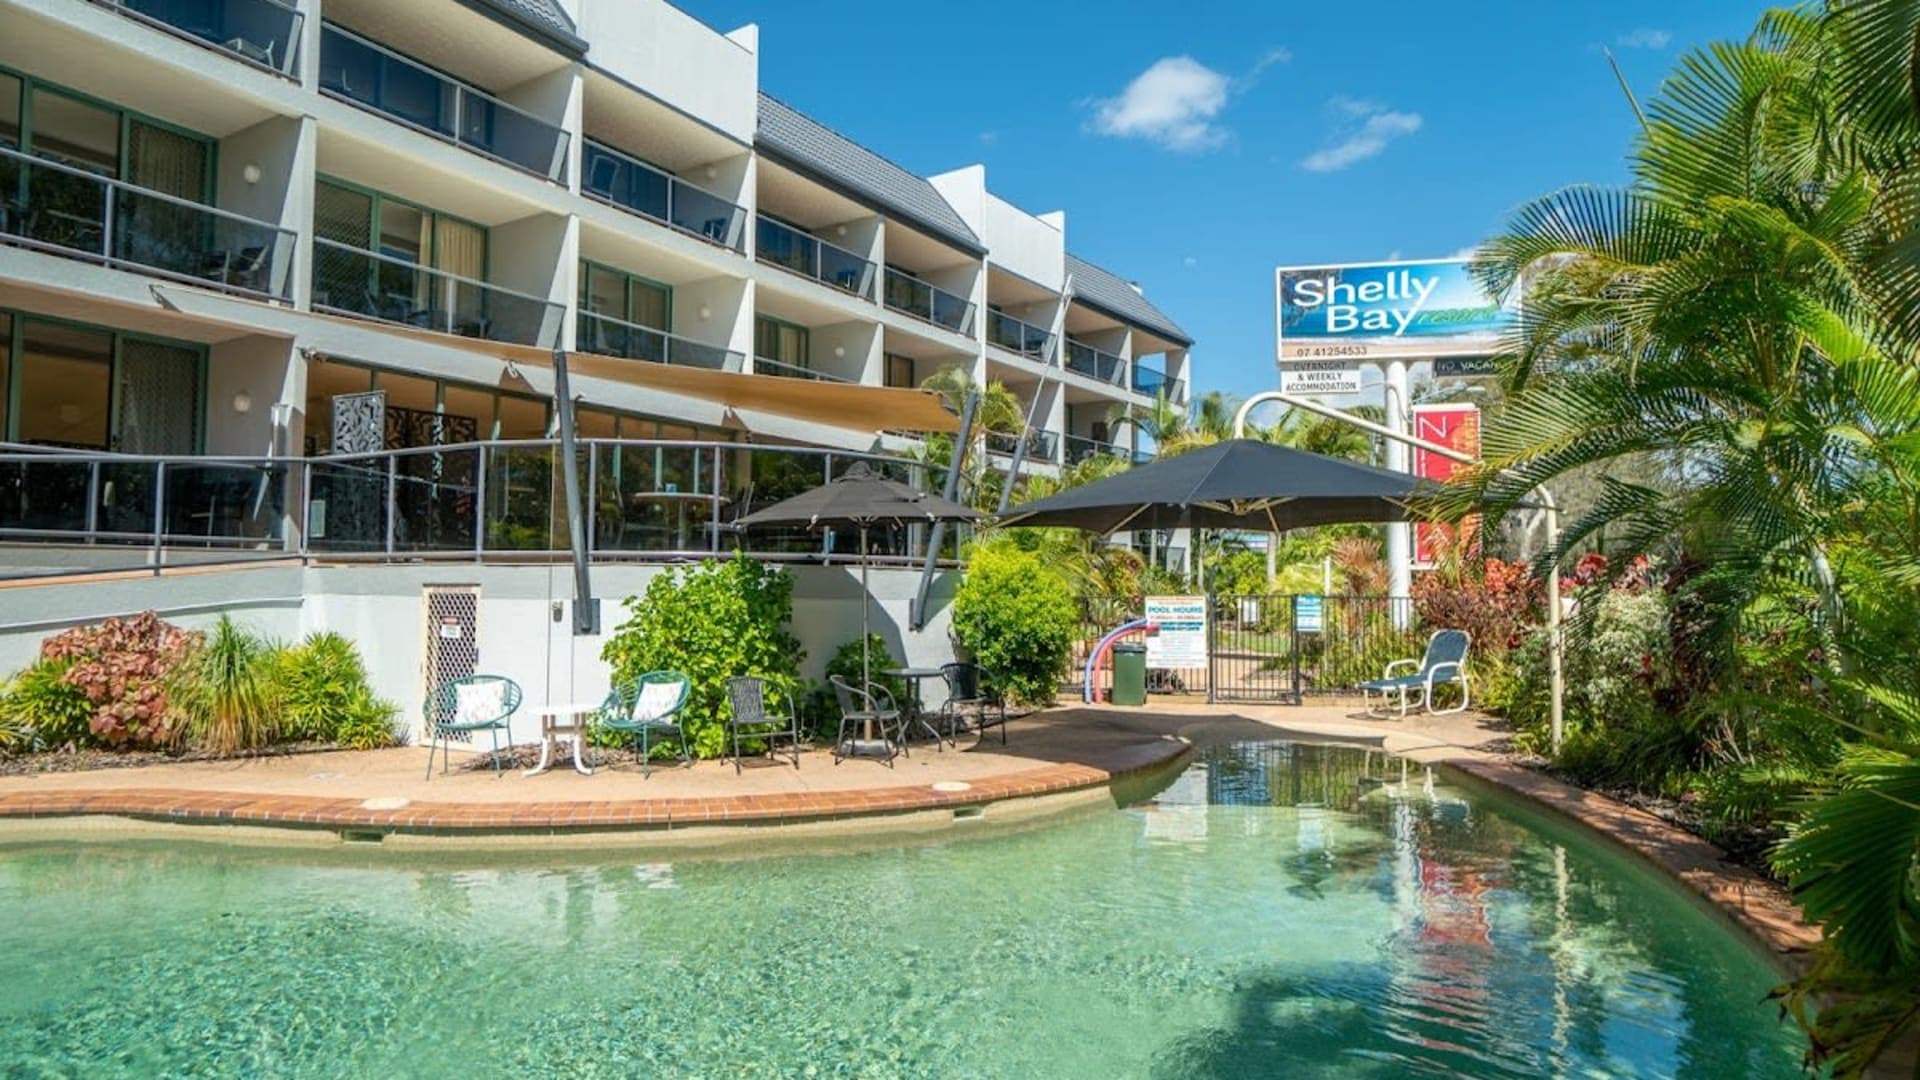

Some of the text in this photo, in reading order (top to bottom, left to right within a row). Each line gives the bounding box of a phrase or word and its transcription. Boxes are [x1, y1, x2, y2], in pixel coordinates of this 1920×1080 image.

[1293, 270, 1440, 309] Shelly
[1327, 305, 1417, 336] Bay
[1297, 346, 1368, 358] 07 41254533
[1294, 361, 1346, 371] OVERNIGHT
[1297, 372, 1343, 381] & WEEKLY
[1286, 381, 1357, 392] ACCOMMODATION
